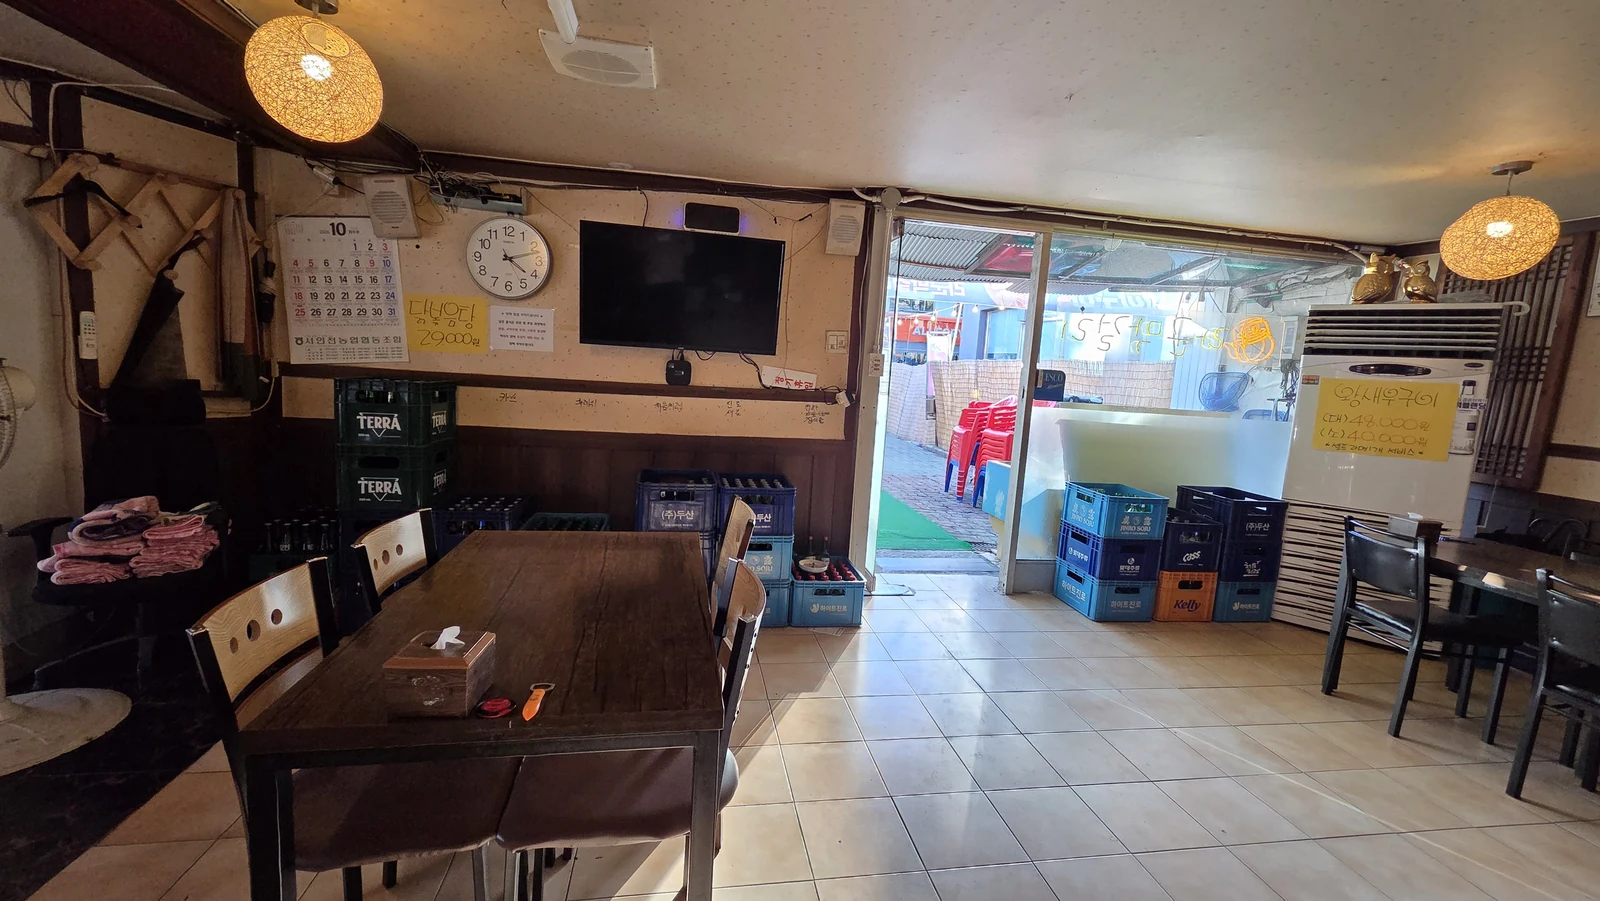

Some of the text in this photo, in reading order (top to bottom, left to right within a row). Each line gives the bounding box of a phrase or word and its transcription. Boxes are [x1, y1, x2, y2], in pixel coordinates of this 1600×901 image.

[329, 222, 346, 236] 10
[487, 229, 498, 240] 11
[502, 226, 515, 237] 12
[520, 231, 525, 241] 1
[478, 238, 491, 250] 10
[530, 241, 540, 253] 2
[474, 251, 482, 262] 9
[535, 256, 543, 266] 3
[292, 259, 391, 267] 4 5 6 7 8 9 10
[479, 265, 487, 276] 8
[530, 269, 538, 279] 4
[293, 276, 392, 284] 11 12 13 14 15 16 17
[491, 276, 499, 287] 7
[520, 278, 528, 289] 5
[504, 280, 512, 292] 6
[294, 292, 395, 300] 18 19 20 21 22 23 24
[295, 308, 396, 316] 25 26 27 28 29 30 31
[356, 415, 402, 431] TERRA
[432, 413, 446, 428] TERRA
[433, 474, 446, 488] TERRA
[358, 480, 402, 495] TERRA
[662, 510, 694, 520] (주)두산
[1246, 522, 1270, 531] (주)두산
[1062, 580, 1086, 602] 하이트진로
[1111, 600, 1142, 608] 하이트진로
[1174, 600, 1201, 612] Kelly
